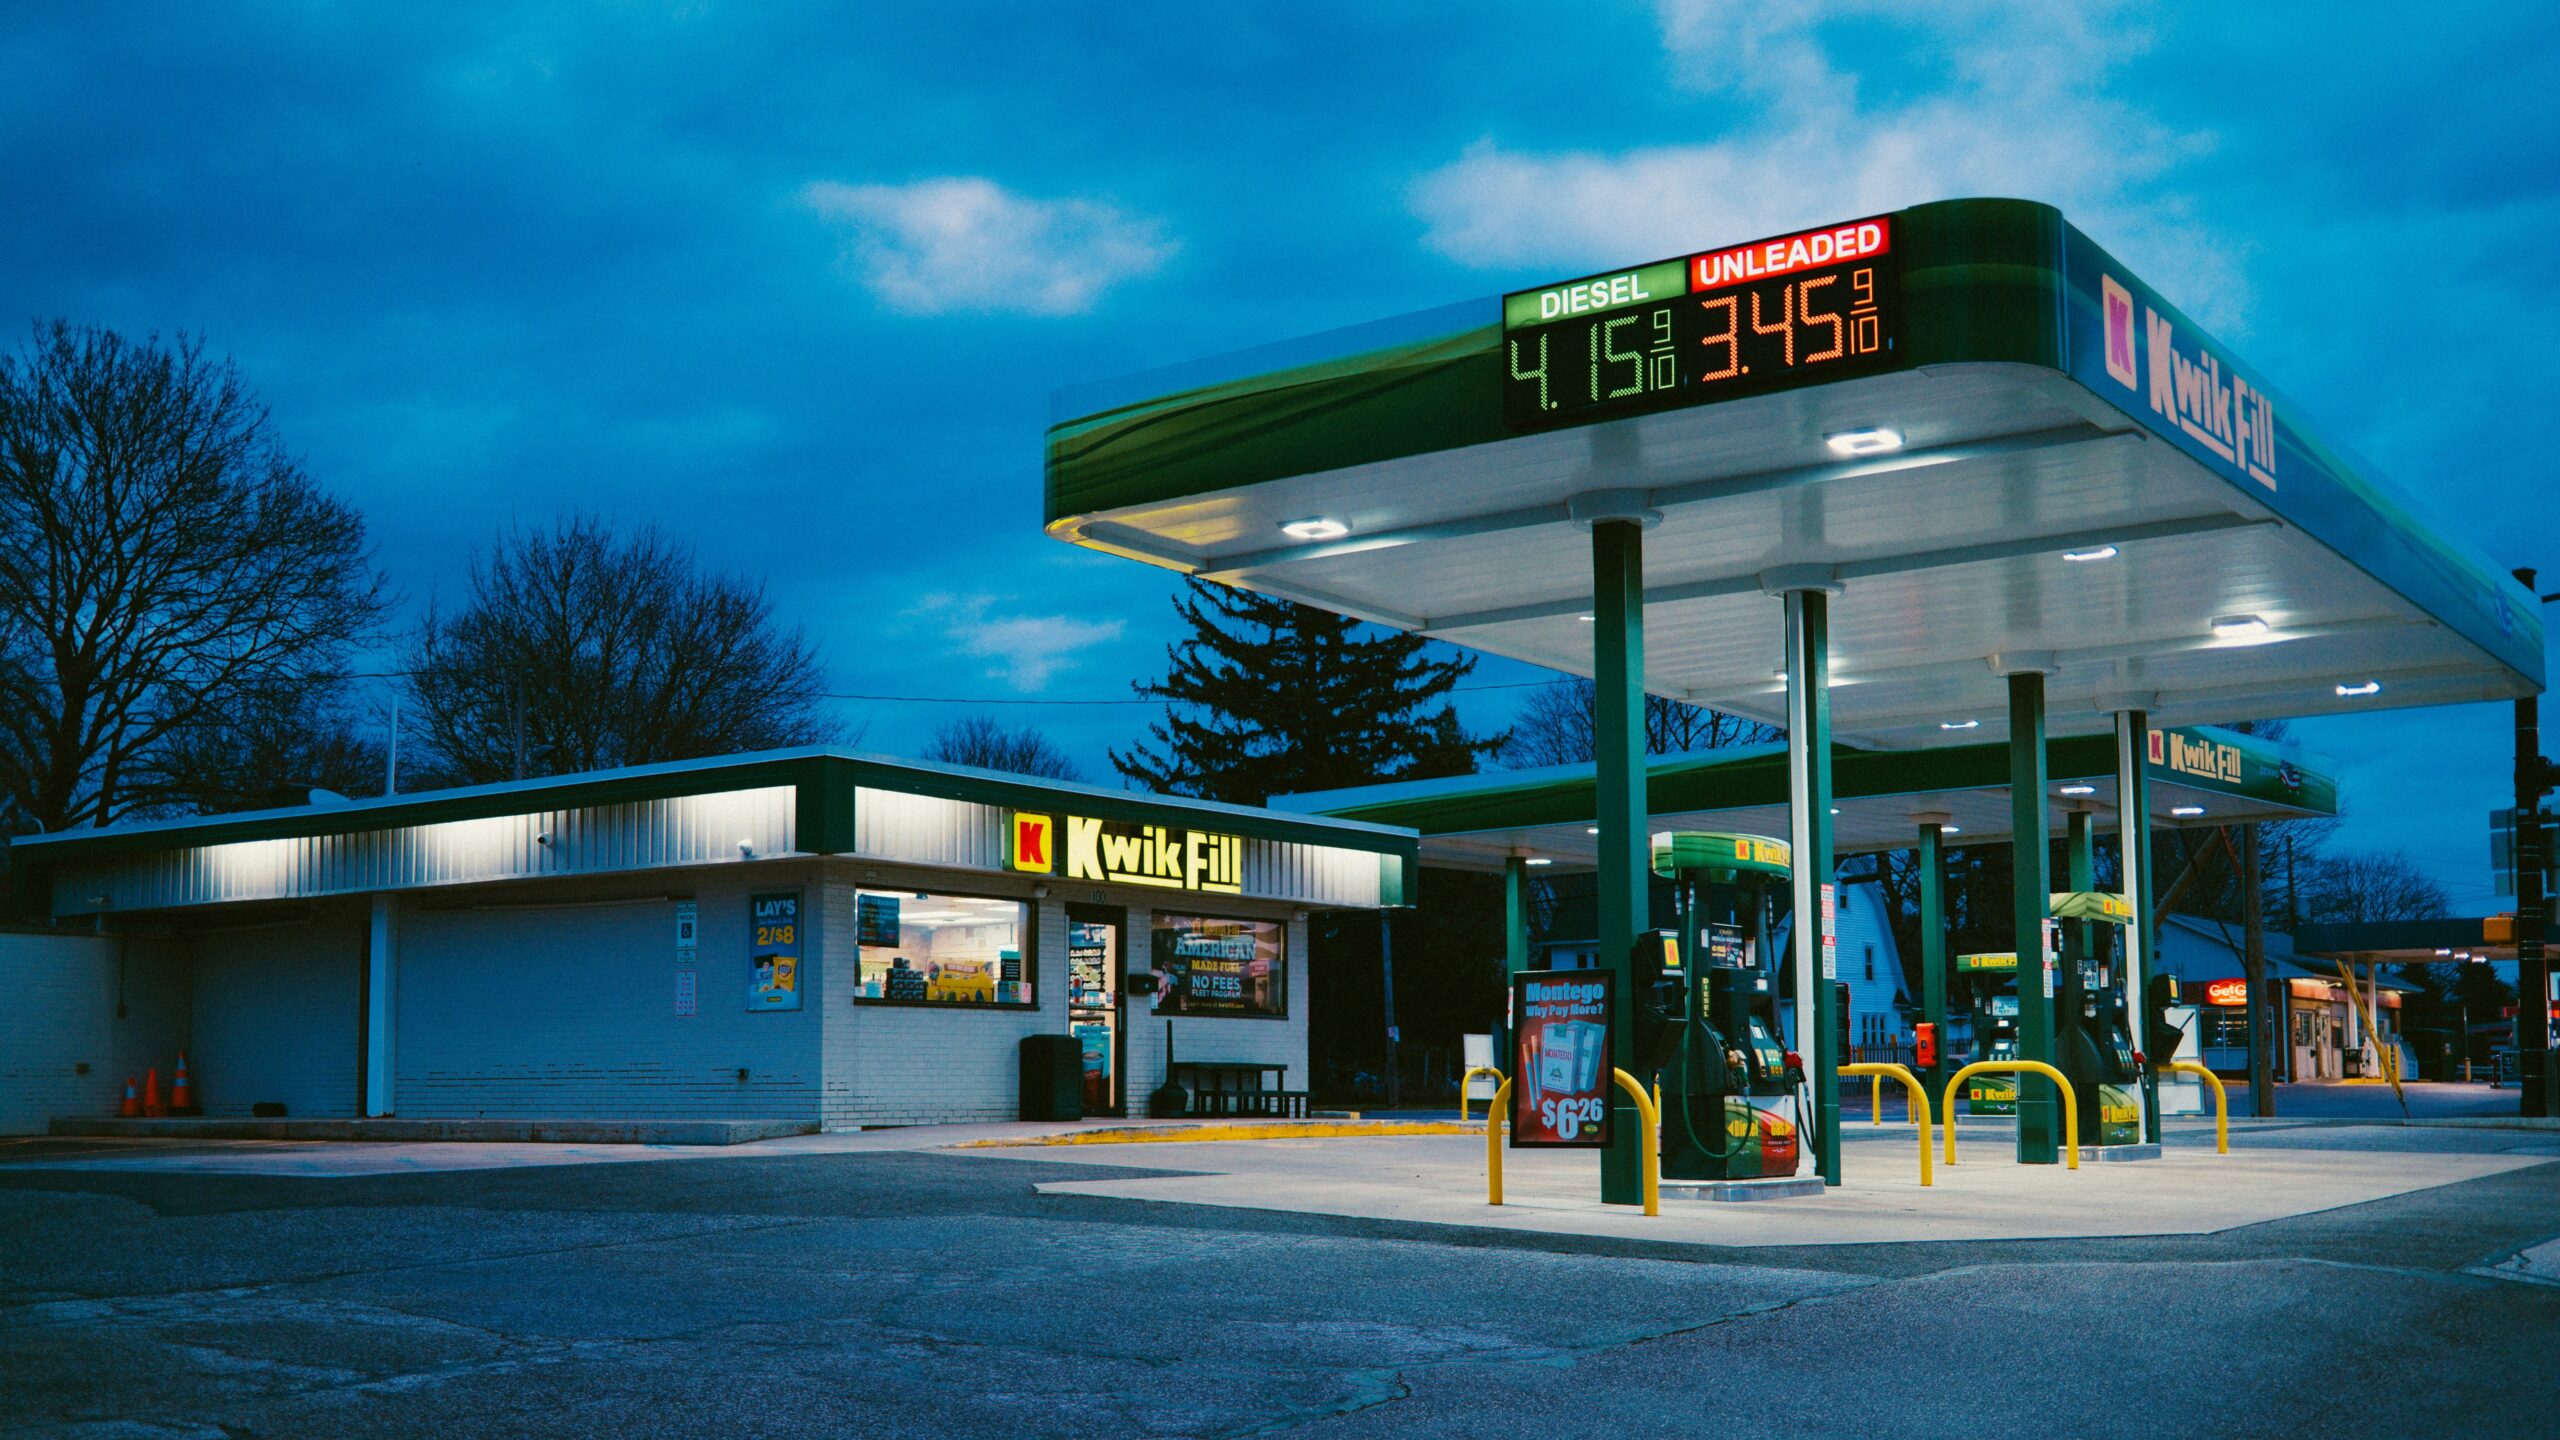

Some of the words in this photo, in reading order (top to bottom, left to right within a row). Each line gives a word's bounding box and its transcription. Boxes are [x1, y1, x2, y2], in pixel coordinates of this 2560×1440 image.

[1700, 224, 1881, 286] UNLEADED
[1541, 274, 1649, 320] DIESEL
[1702, 275, 1843, 382] 3.45
[1511, 315, 1643, 411] 4.15
[2146, 305, 2235, 455] Kwik
[2170, 733, 2217, 778] Kwik
[2217, 744, 2241, 782] Fill
[1020, 821, 1045, 864] K
[1067, 815, 1183, 886] Kwik
[1186, 830, 1241, 892] Fill
[756, 900, 797, 917] LAY'S
[757, 925, 795, 946] 2/$8
[1174, 936, 1256, 960] AMERICAN
[1191, 960, 1218, 971] MADE
[1219, 961, 1241, 973] FUEL
[1191, 975, 1210, 989] NO
[1212, 976, 1241, 990] FEES
[1526, 982, 1605, 1005] Montego
[2209, 984, 2247, 997] GetG
[1191, 990, 1210, 998] FLEET
[1211, 990, 1241, 999] PROGRAM
[1702, 977, 1710, 1018] DIESEL
[1526, 1005, 1547, 1019] Why
[1549, 1004, 1569, 1018] Pay
[1570, 1003, 1604, 1016] More?
[1545, 1048, 1573, 1062] MONTEGO
[1734, 1119, 1758, 1137] Dieel
[1771, 1119, 1785, 1136] Gas
